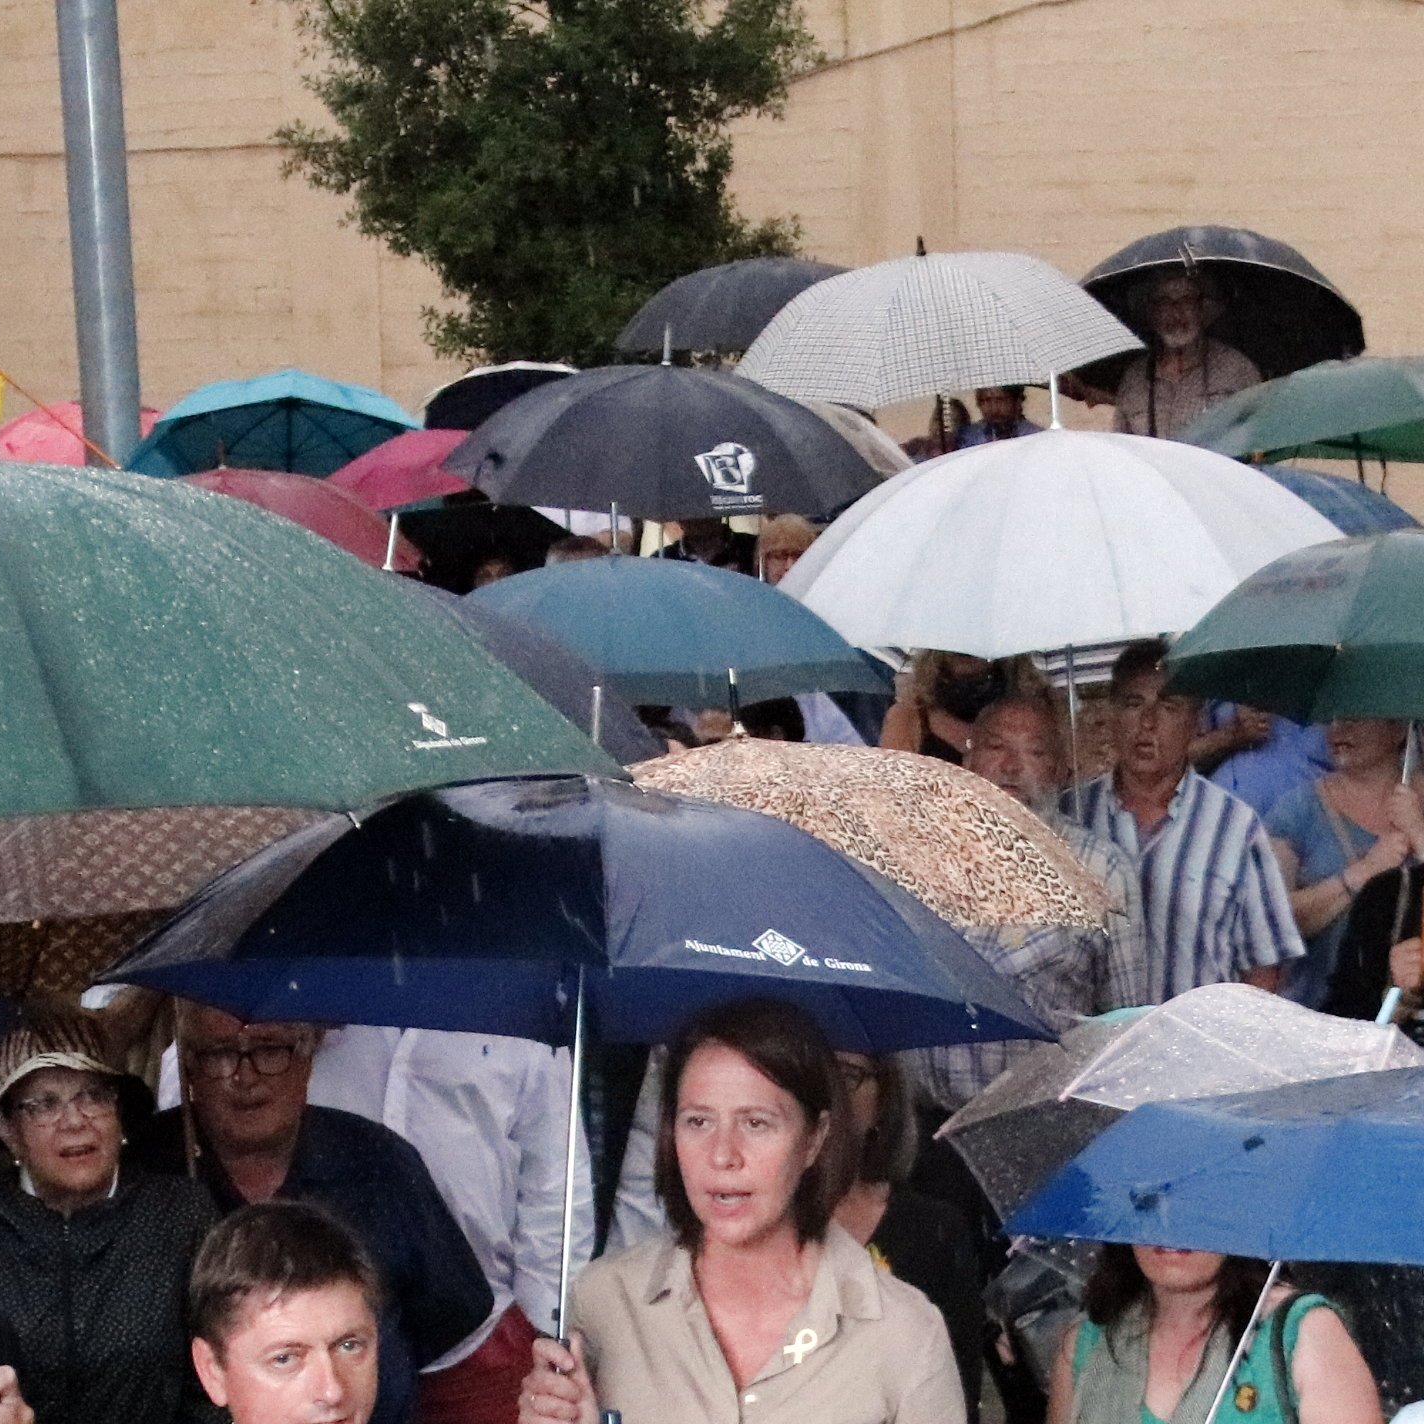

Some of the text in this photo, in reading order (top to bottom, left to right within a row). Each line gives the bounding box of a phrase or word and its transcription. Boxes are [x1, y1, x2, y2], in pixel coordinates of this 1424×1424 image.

[684, 939, 872, 972] Ajuntament de Girona
